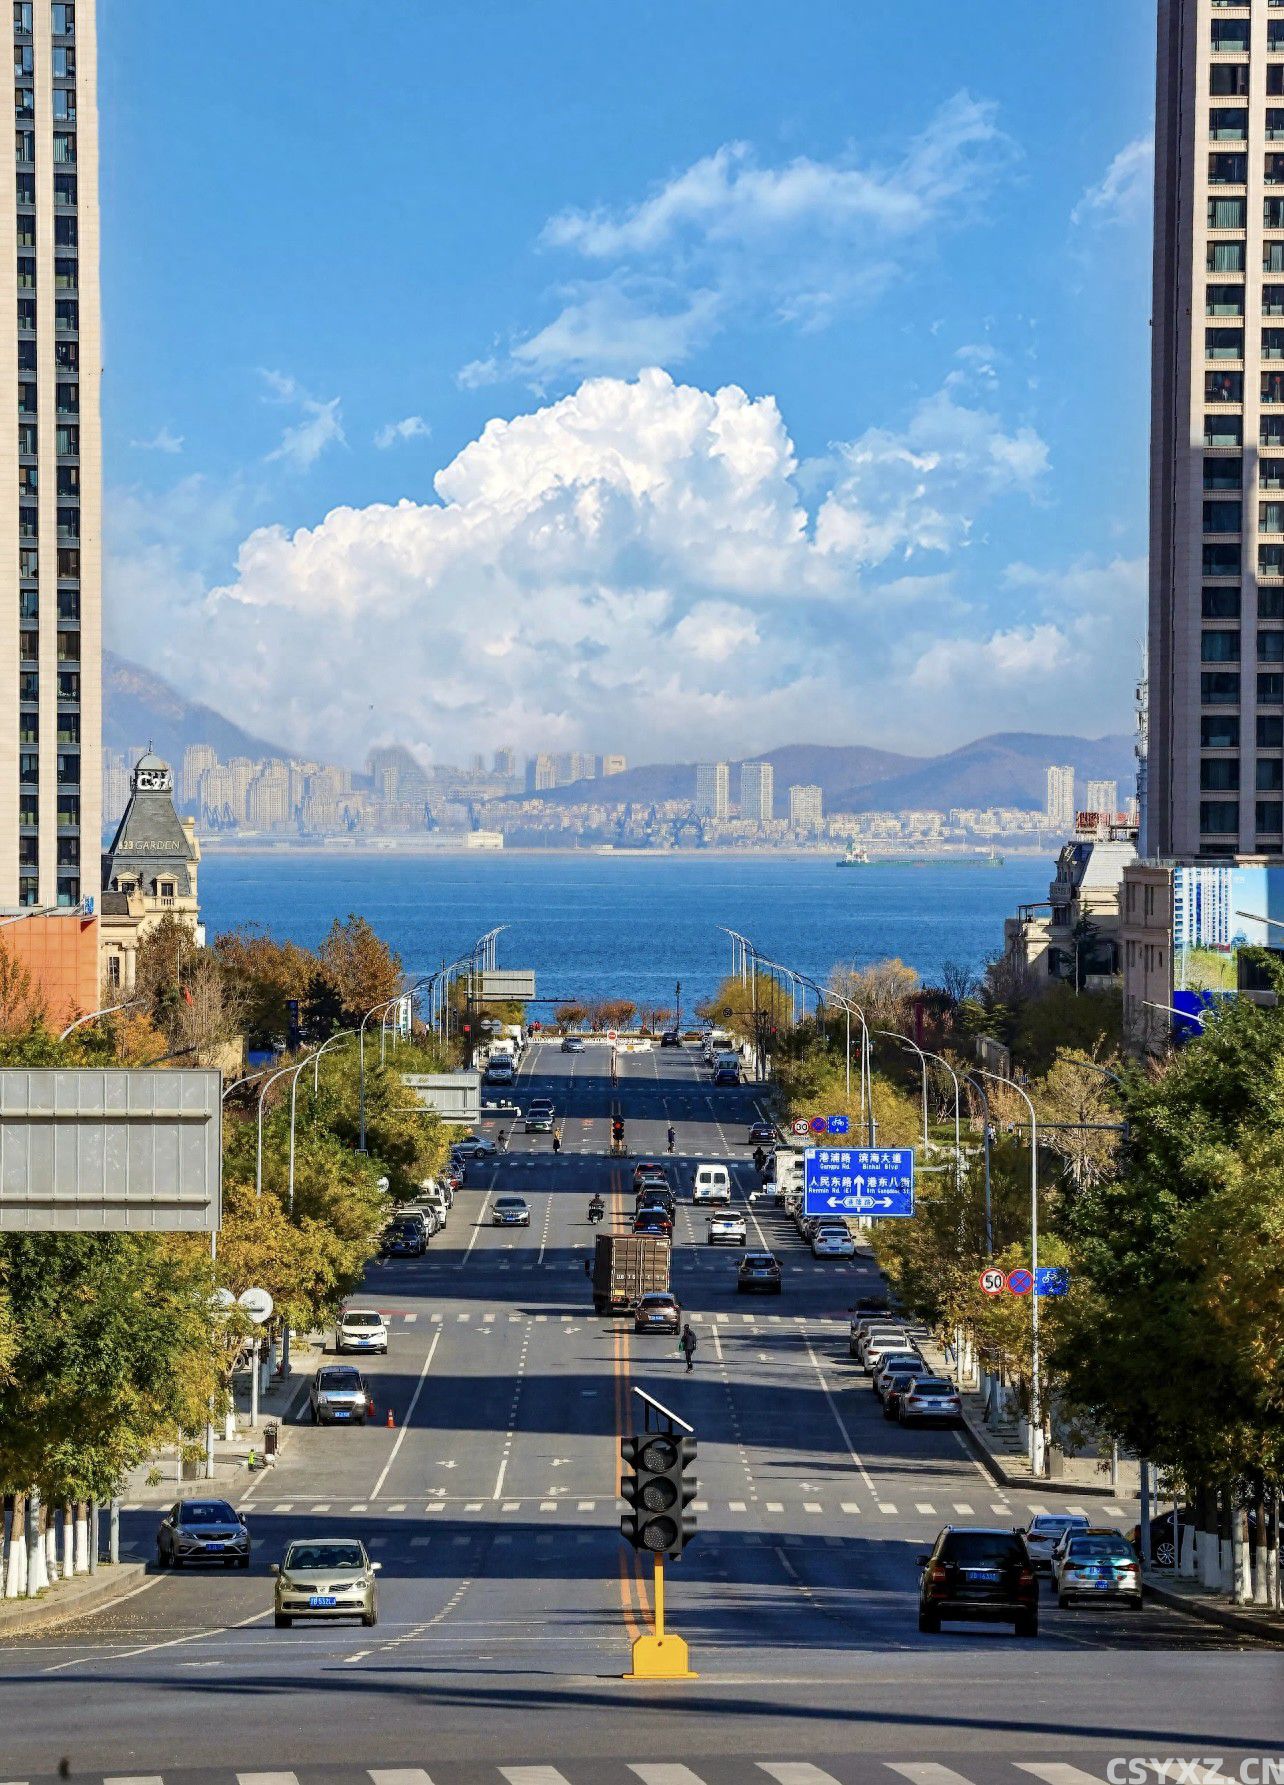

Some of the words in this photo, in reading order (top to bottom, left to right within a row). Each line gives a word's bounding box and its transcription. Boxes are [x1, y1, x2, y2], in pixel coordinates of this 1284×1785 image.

[135, 840, 180, 850] GARDEN
[796, 1123, 808, 1131] 30
[819, 1152, 851, 1164] 港浦路
[859, 1152, 902, 1164] 滨海大道
[810, 1176, 852, 1188] 人民东路
[867, 1176, 910, 1188] 港东八街
[985, 1275, 1002, 1289] 50
